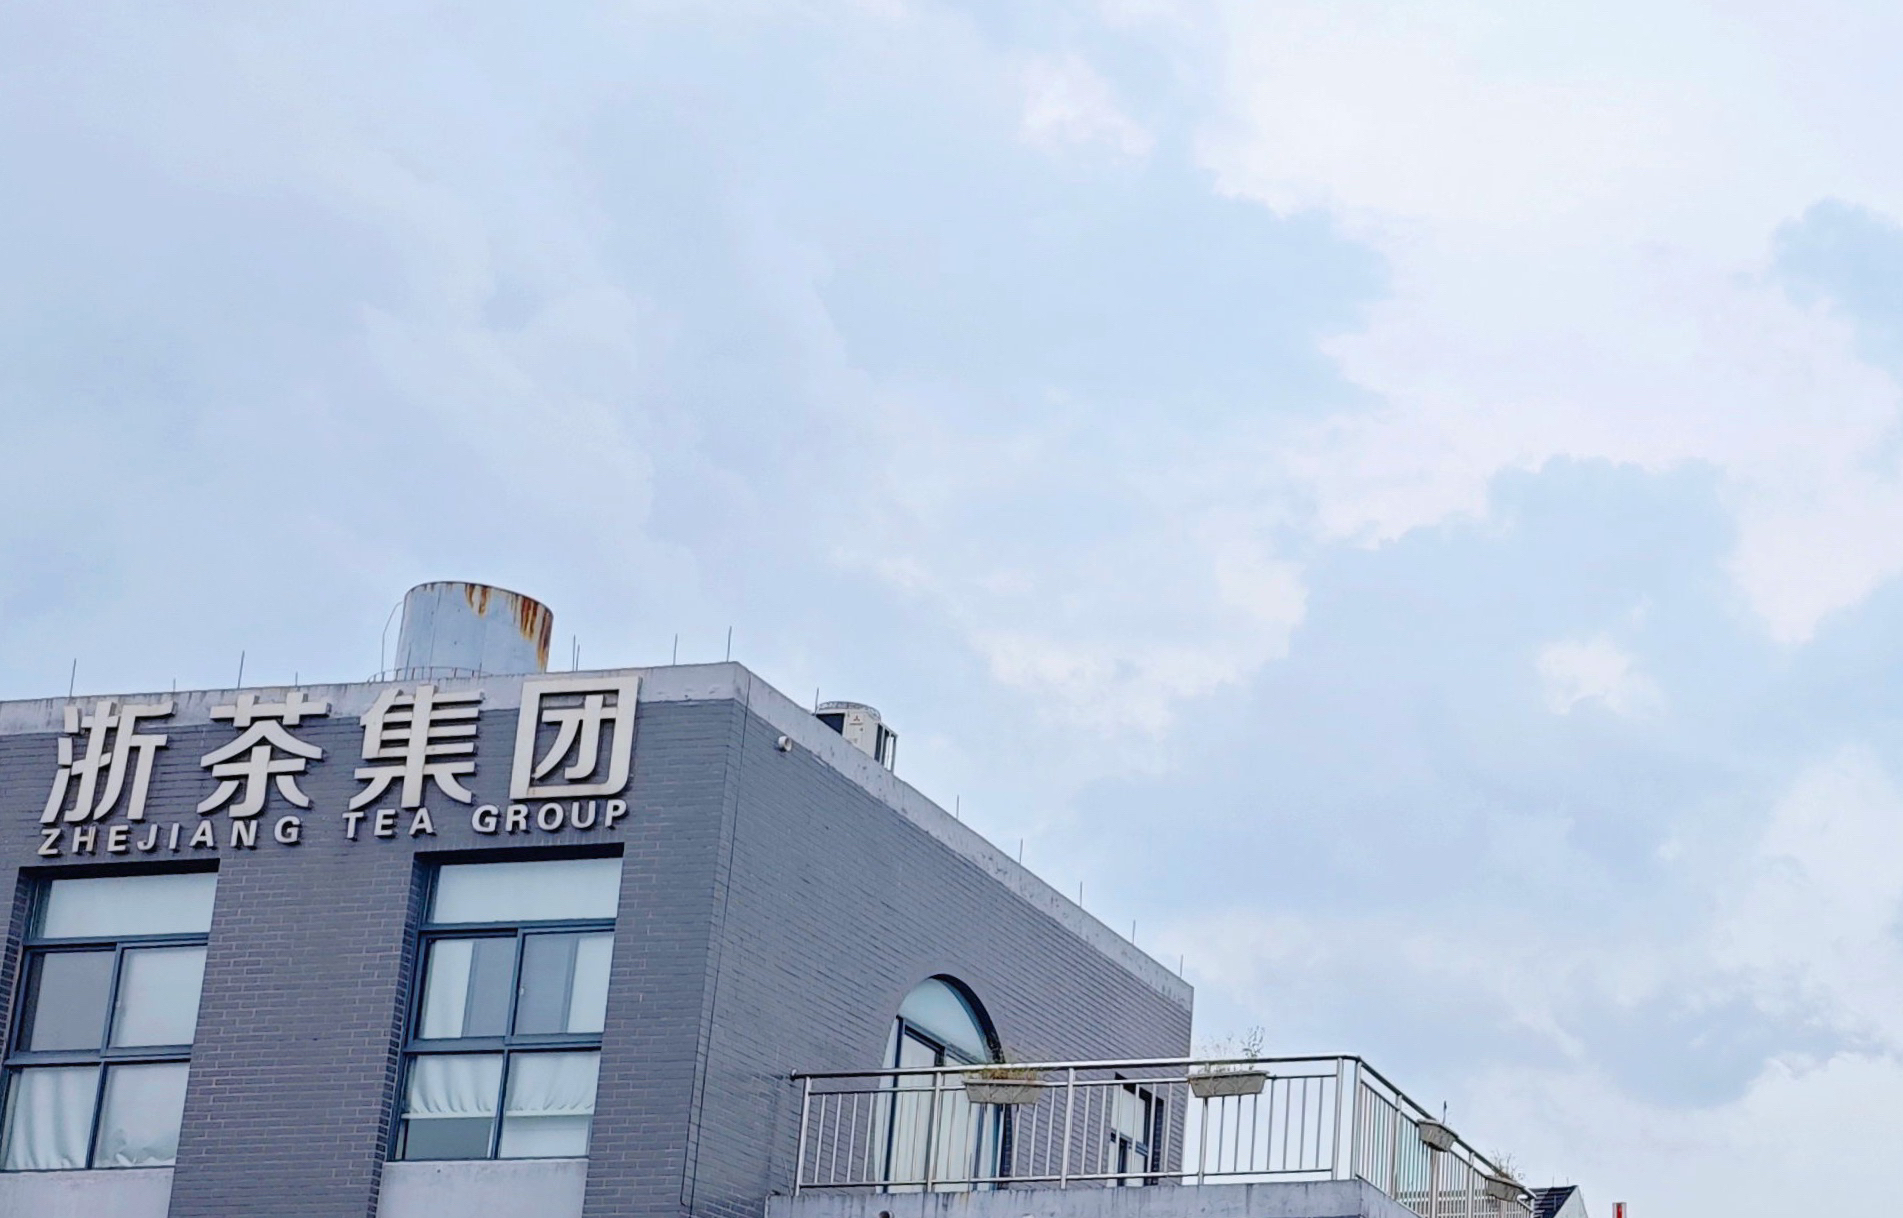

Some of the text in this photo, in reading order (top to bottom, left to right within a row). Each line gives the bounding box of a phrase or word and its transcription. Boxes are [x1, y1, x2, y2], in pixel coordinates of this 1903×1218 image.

[40, 676, 642, 824] 浙茶集团
[38, 799, 630, 857] ZHEJIANG TEA GROUP
